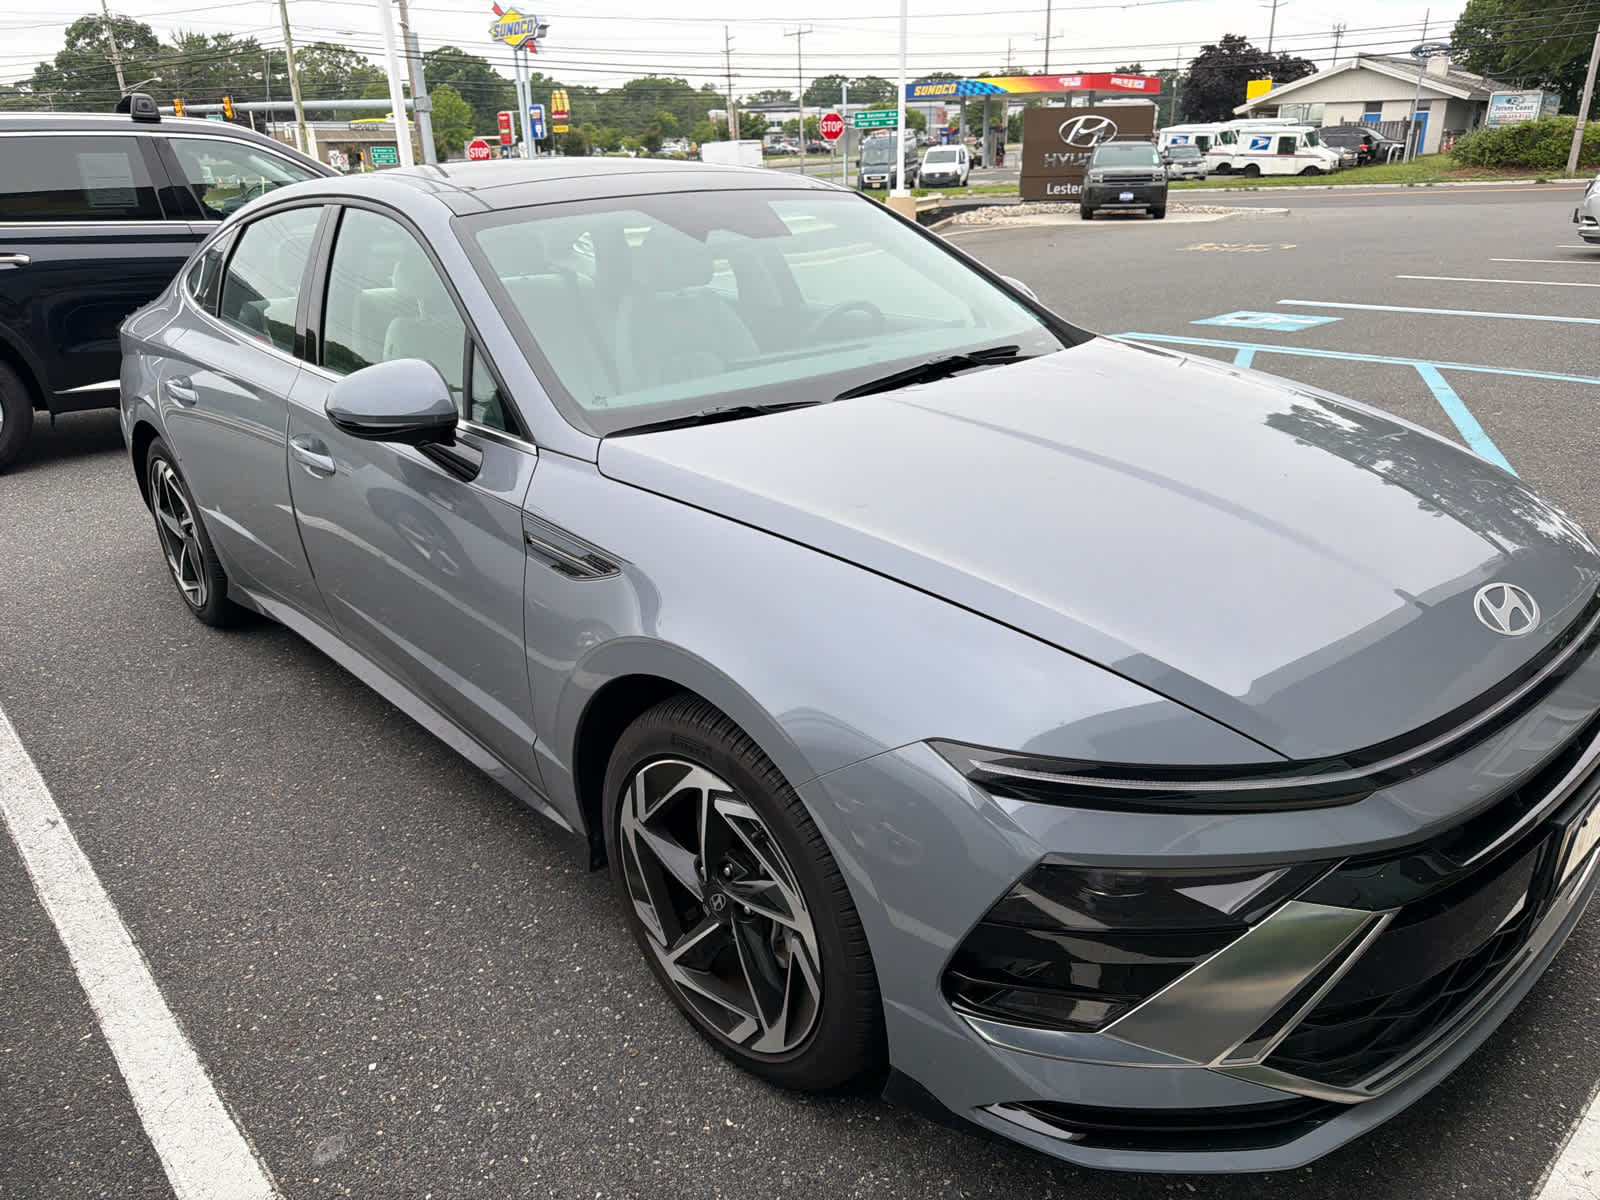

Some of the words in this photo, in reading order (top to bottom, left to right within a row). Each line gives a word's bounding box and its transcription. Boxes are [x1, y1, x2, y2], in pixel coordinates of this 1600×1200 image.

[493, 19, 534, 38] SUNOCO
[913, 83, 958, 96] SUNOCO
[821, 121, 842, 133] STOP
[469, 147, 489, 158] STOP
[1046, 183, 1083, 195] Lester
